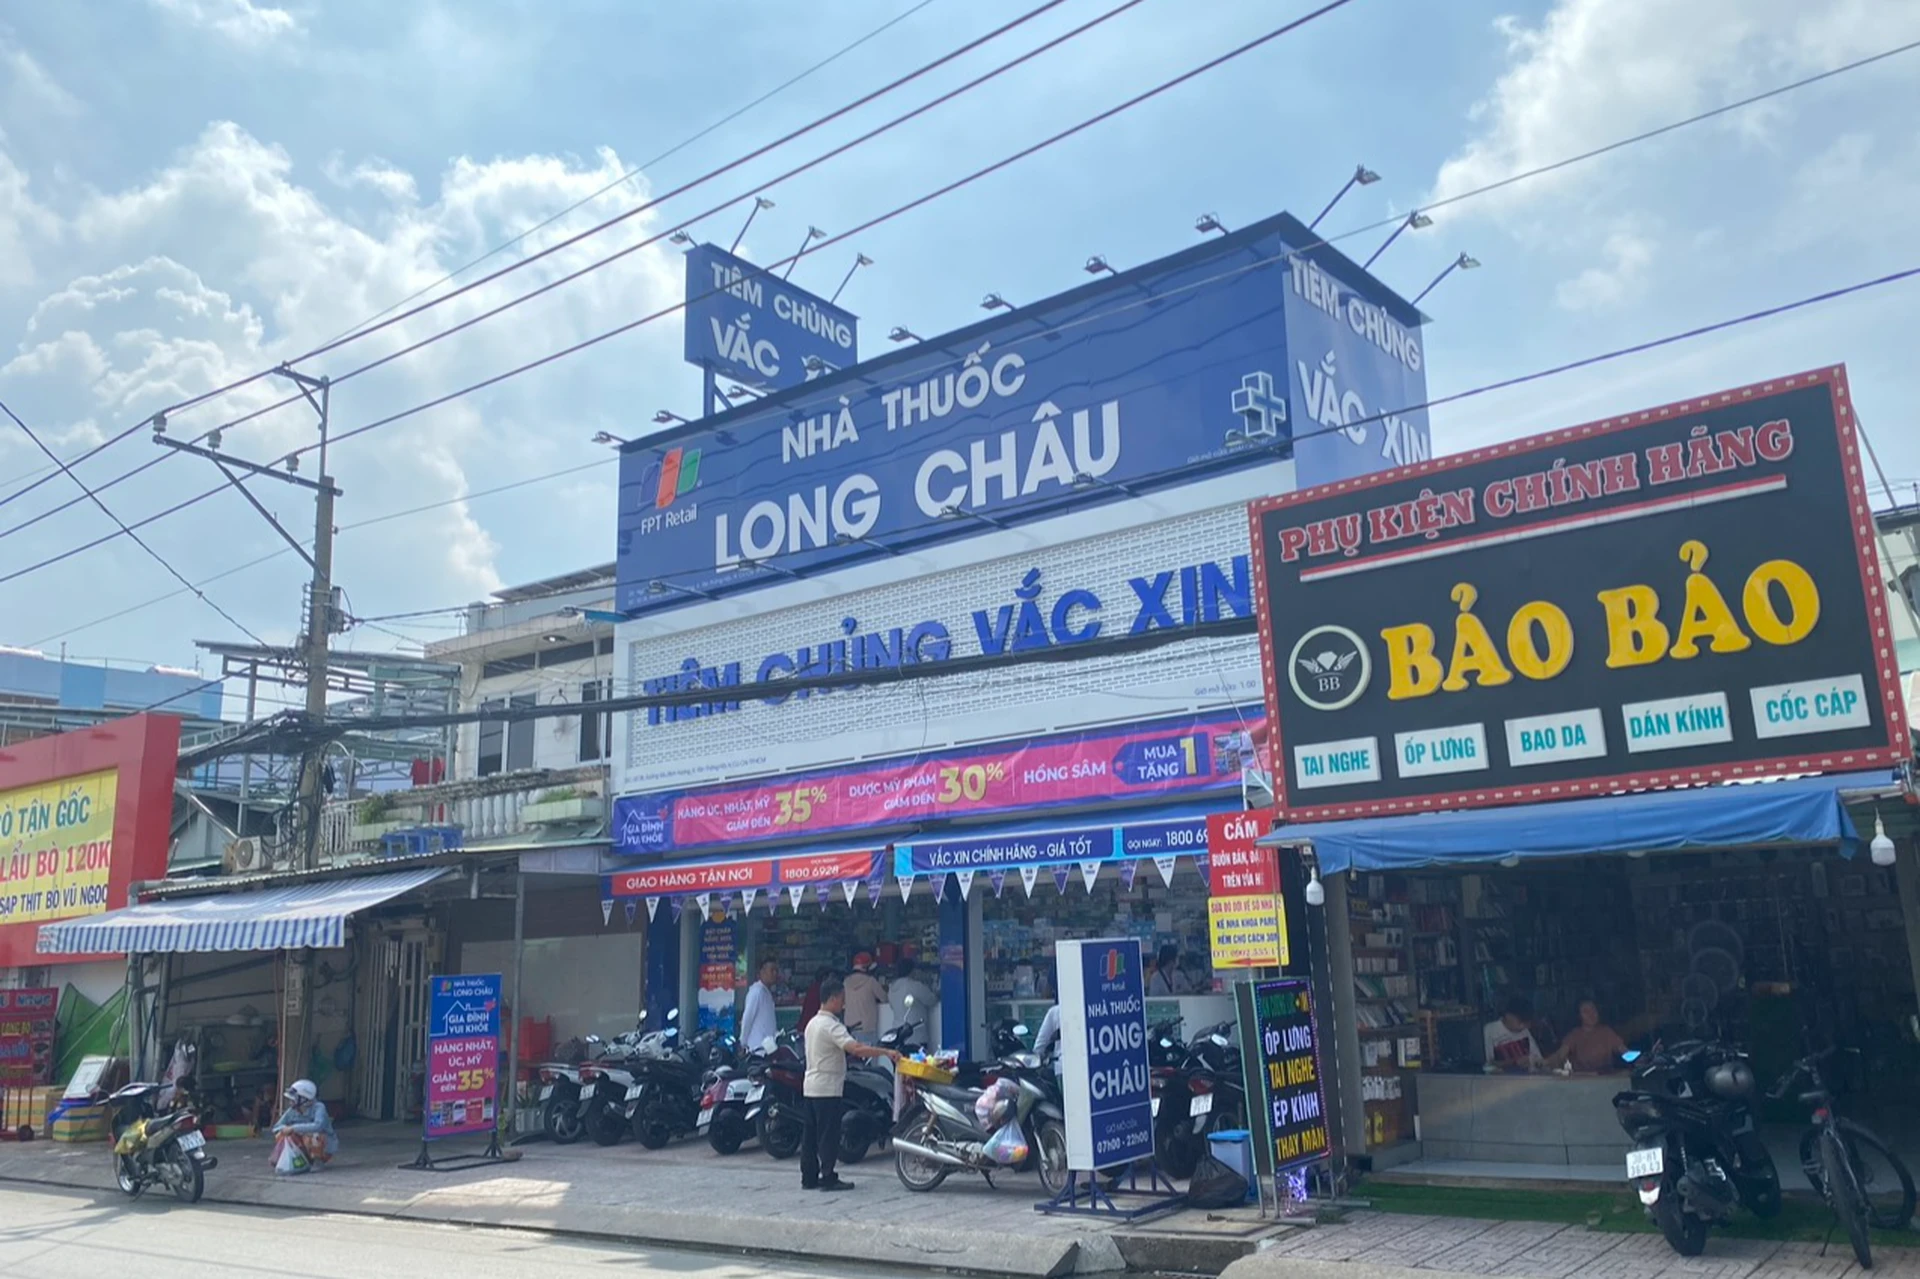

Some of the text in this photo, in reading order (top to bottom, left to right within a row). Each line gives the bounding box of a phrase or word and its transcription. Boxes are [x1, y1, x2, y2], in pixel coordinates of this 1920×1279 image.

[711, 261, 853, 349] TIÊM CHỦNG
[1289, 255, 1421, 372] TIÊM CHỦNG
[709, 312, 780, 377] VẮC
[782, 341, 1025, 464] NHÀ THUỐC
[1298, 349, 1430, 466] VẮC XIN
[715, 400, 1121, 574] LONG CHÂU
[1279, 418, 1794, 562] PHỤ KIỆN CHÍNH HÃNG
[641, 504, 697, 535] FPT Retail
[1380, 540, 1820, 700] BẢO BẢO
[643, 555, 1251, 725] TIÊM CHỦNG VẮC XIN
[1318, 676, 1341, 692] BB
[1765, 686, 1857, 723] CỐC CÁP
[1630, 705, 1724, 739] DÁN KÍNH
[1144, 745, 1177, 760] MUA
[1404, 736, 1476, 765] ỐP LƯNG
[1520, 724, 1587, 752] BAO DA
[1024, 758, 1106, 784] HỒNG SÂM
[1180, 736, 1197, 776] 1
[1302, 749, 1370, 776] TAI NGHE
[849, 773, 936, 798] DƯỢC MỸ PHẨM
[938, 762, 1004, 805] 30%
[1138, 762, 1179, 782] TẶNG
[0, 786, 91, 838] Ò TẬN GỐC
[755, 795, 770, 809] MỸ
[774, 785, 827, 826] 35%
[884, 789, 936, 810] GIẢM ĐẾN
[727, 815, 771, 832] GIẢM ĐẾN
[1224, 813, 1258, 841] CẤM
[929, 853, 951, 867] VẮC
[953, 851, 971, 865] XIN
[972, 845, 1004, 863] CHÍNH
[1006, 843, 1037, 860] HÃNG
[1047, 841, 1067, 857] GIÁ
[1070, 835, 1092, 855] TỐT
[1127, 840, 1140, 851] GỌI
[1141, 838, 1162, 849] NGAY:
[1166, 830, 1193, 847] 1800
[36, 841, 59, 877] BÒ
[65, 840, 112, 874] 120K
[785, 867, 810, 879] 1800
[812, 865, 839, 877] 6928
[626, 868, 752, 890] GIAO HÀNG TẬN NƠI
[1222, 871, 1241, 888] TRÊN
[20, 891, 43, 915] THỊT
[45, 885, 60, 909] BÒ
[63, 883, 77, 907] VŨ
[453, 989, 473, 997] LONG
[474, 986, 493, 996] CHÂU
[1088, 994, 1140, 1018] NHÀ THUỐC
[448, 1011, 489, 1024] GIA ĐÌNH
[449, 1022, 489, 1034] VUI KHỎE
[434, 1039, 493, 1054] HÀNG NHẬT,
[1090, 1022, 1143, 1055] LONG
[1265, 1023, 1312, 1056] ỐP LƯNG
[448, 1053, 482, 1067] ÚC, MỸ
[1269, 1056, 1315, 1089] TAI NGHE
[432, 1069, 457, 1083] GIẢM
[457, 1067, 495, 1092] 35%
[1091, 1059, 1146, 1100] CHÂU
[1273, 1090, 1319, 1128] ÉP KÍNH
[1097, 1137, 1121, 1153] 07h00
[1126, 1130, 1148, 1147] 22h00
[1276, 1124, 1325, 1160] THAY MÀN
